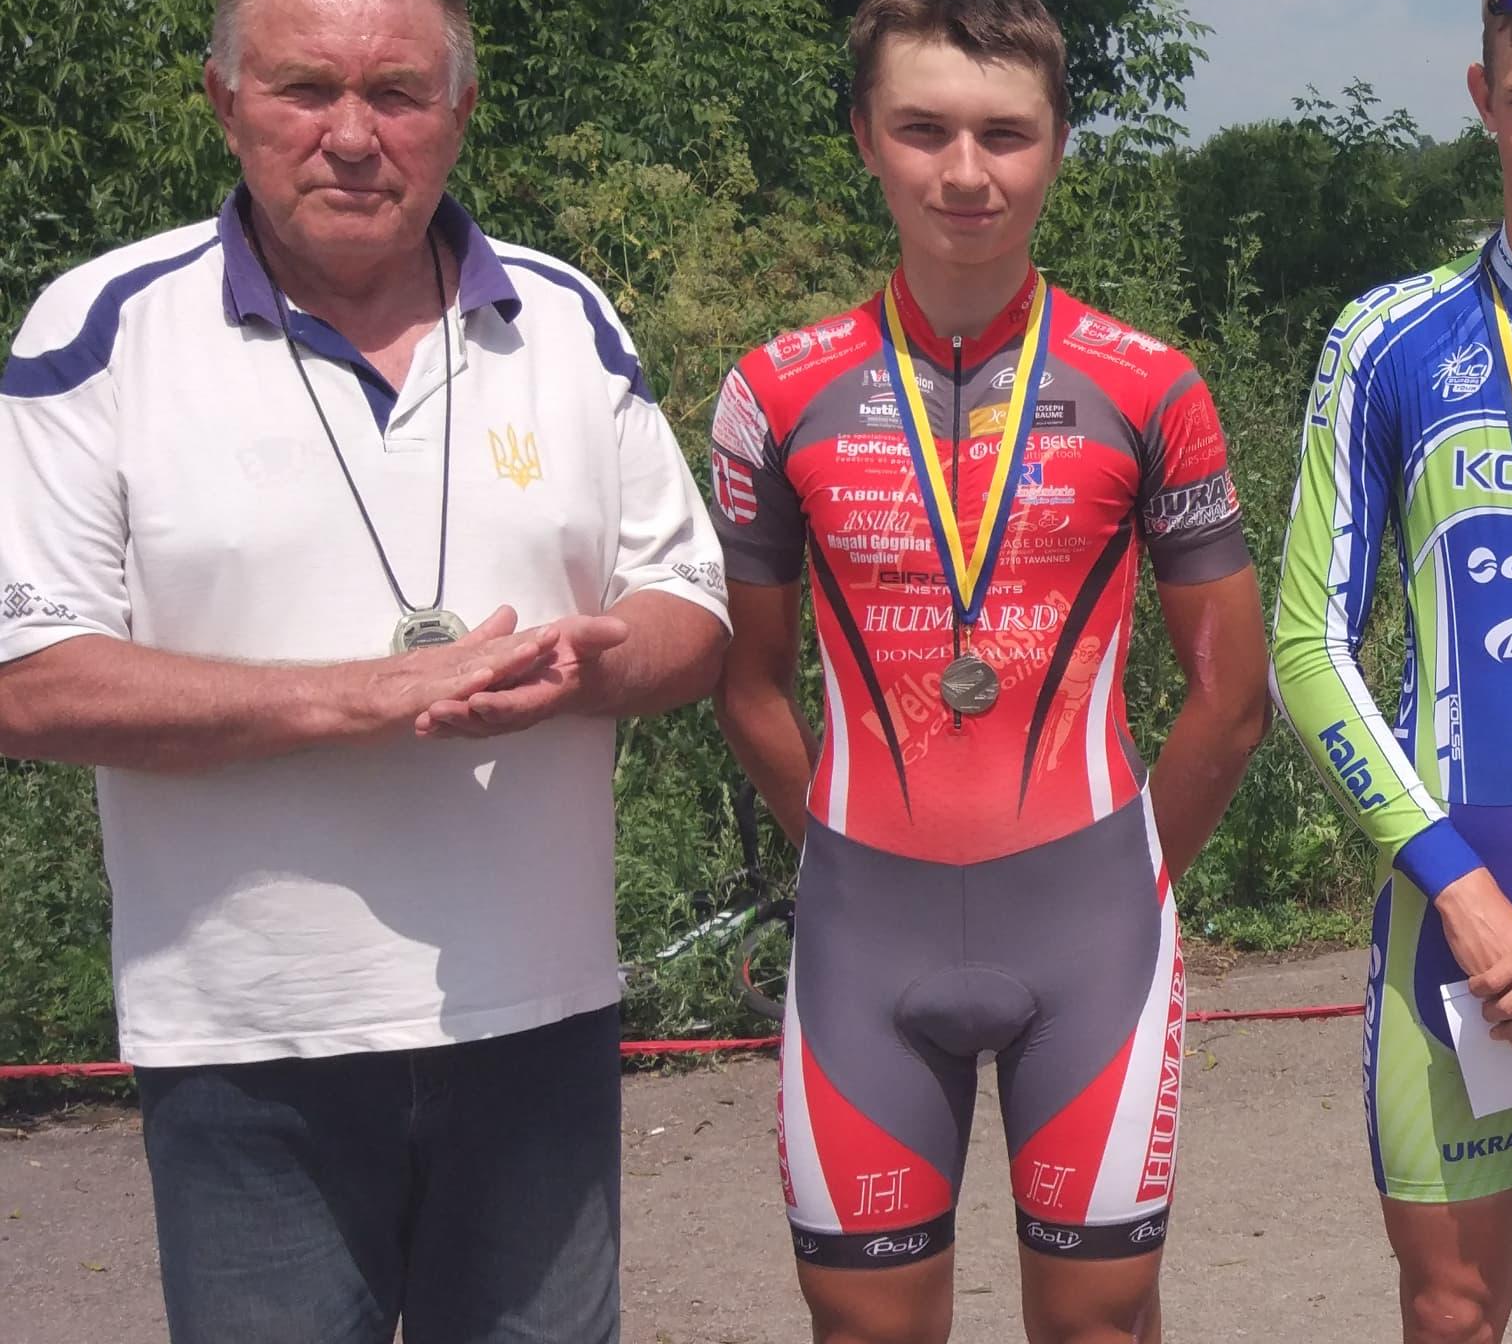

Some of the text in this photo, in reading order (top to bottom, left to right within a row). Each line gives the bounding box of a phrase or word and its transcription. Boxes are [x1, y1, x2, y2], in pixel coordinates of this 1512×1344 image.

[1310, 274, 1434, 428] KOLSS
[1456, 364, 1488, 376] UCI
[837, 440, 911, 457] EgoKiefe
[1040, 435, 1085, 450] BELET
[1035, 538, 1054, 548] DU
[1057, 537, 1086, 547] LION
[1024, 555, 1071, 565] TAVANNES
[1449, 693, 1463, 762] KOLSS
[1318, 719, 1388, 810] kalas
